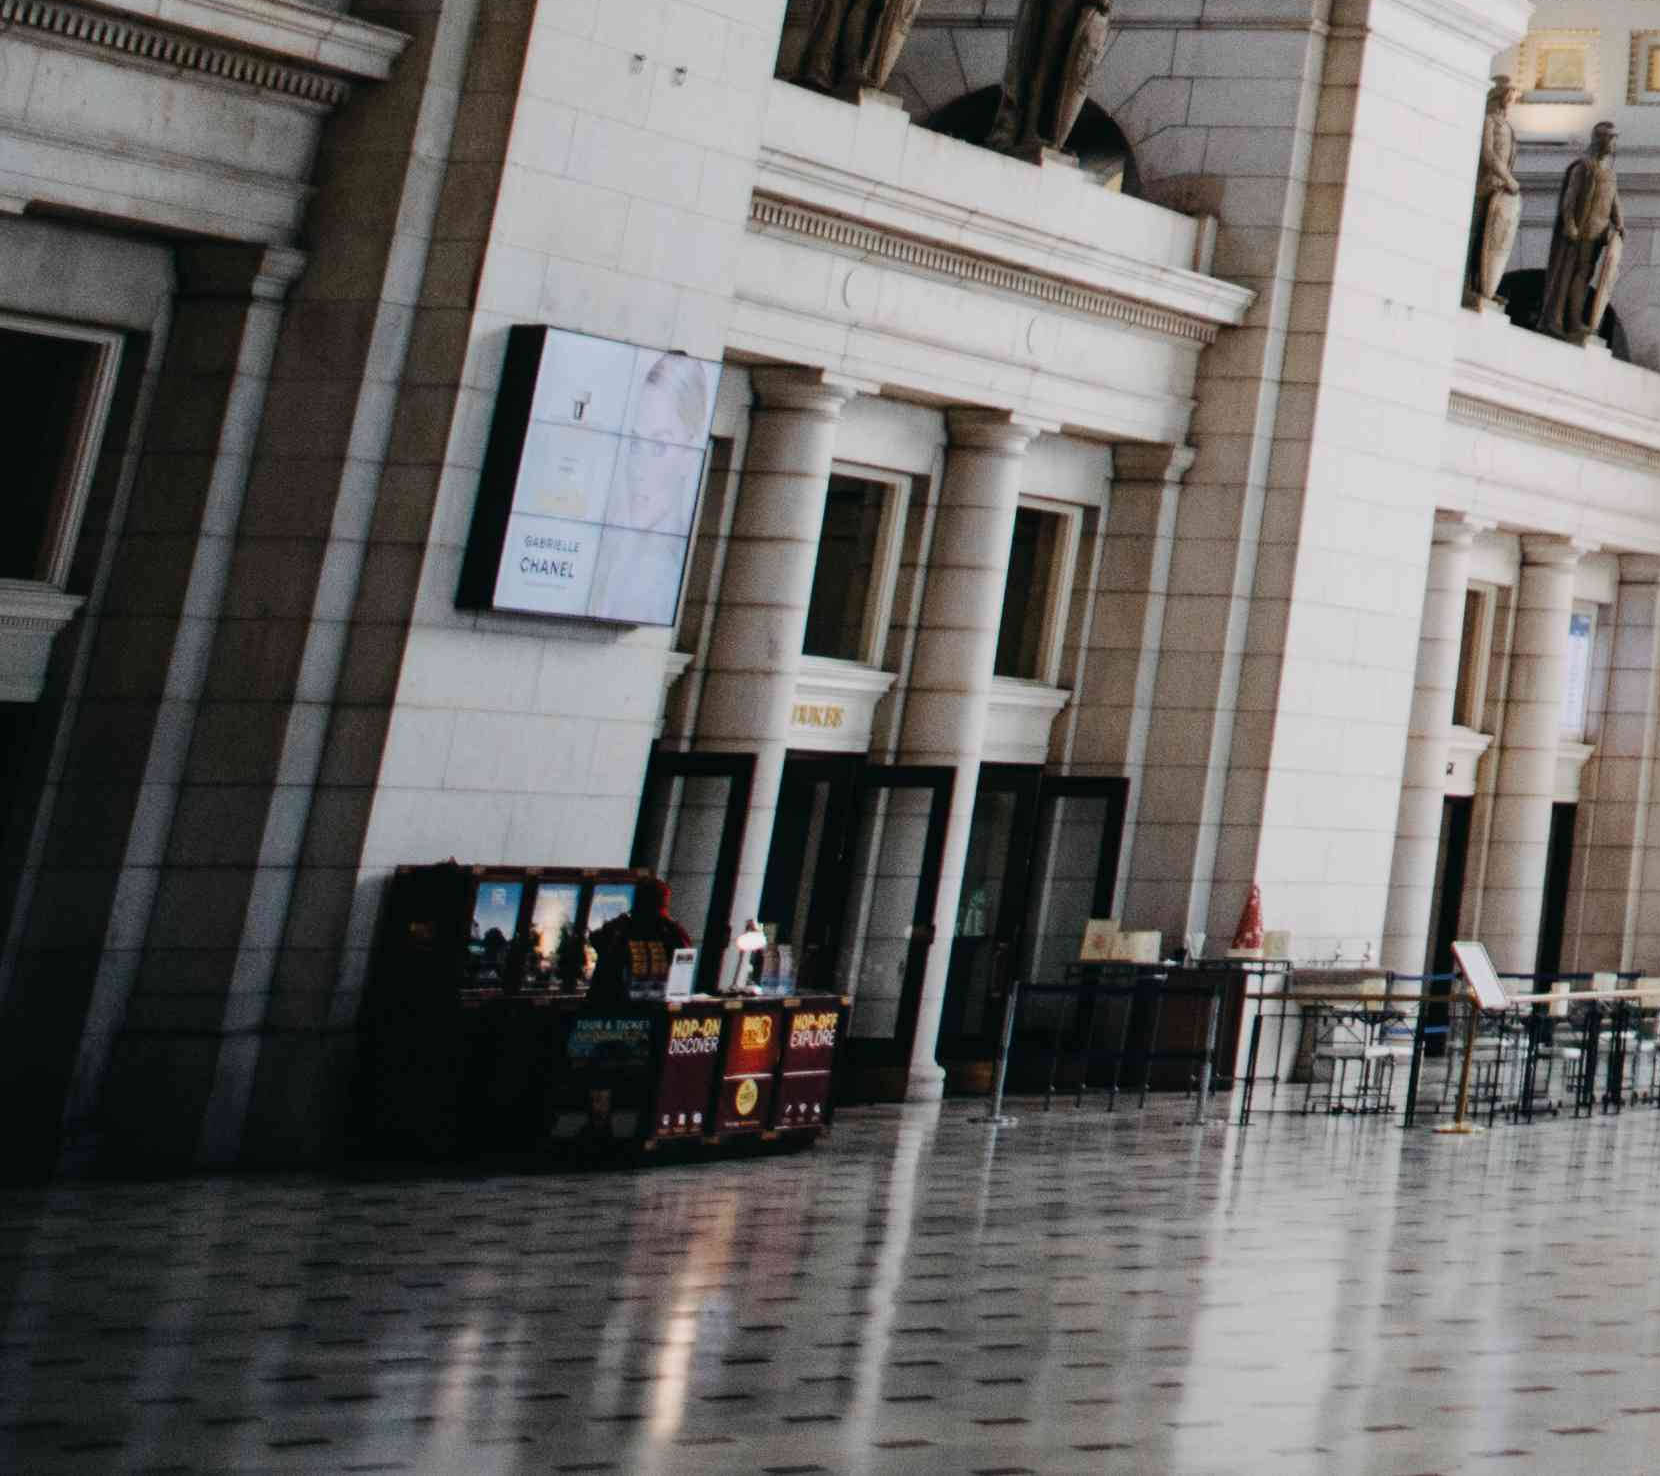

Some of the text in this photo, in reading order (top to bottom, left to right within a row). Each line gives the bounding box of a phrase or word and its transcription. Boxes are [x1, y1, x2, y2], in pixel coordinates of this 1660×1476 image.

[524, 535, 581, 553] GABRIELLE
[519, 556, 574, 578] CHANEL
[671, 1017, 722, 1038] HOP-ON
[792, 1012, 839, 1032] HOP-OFF
[668, 1036, 720, 1056] DISCOVER
[790, 1029, 837, 1050] EXPLORE
